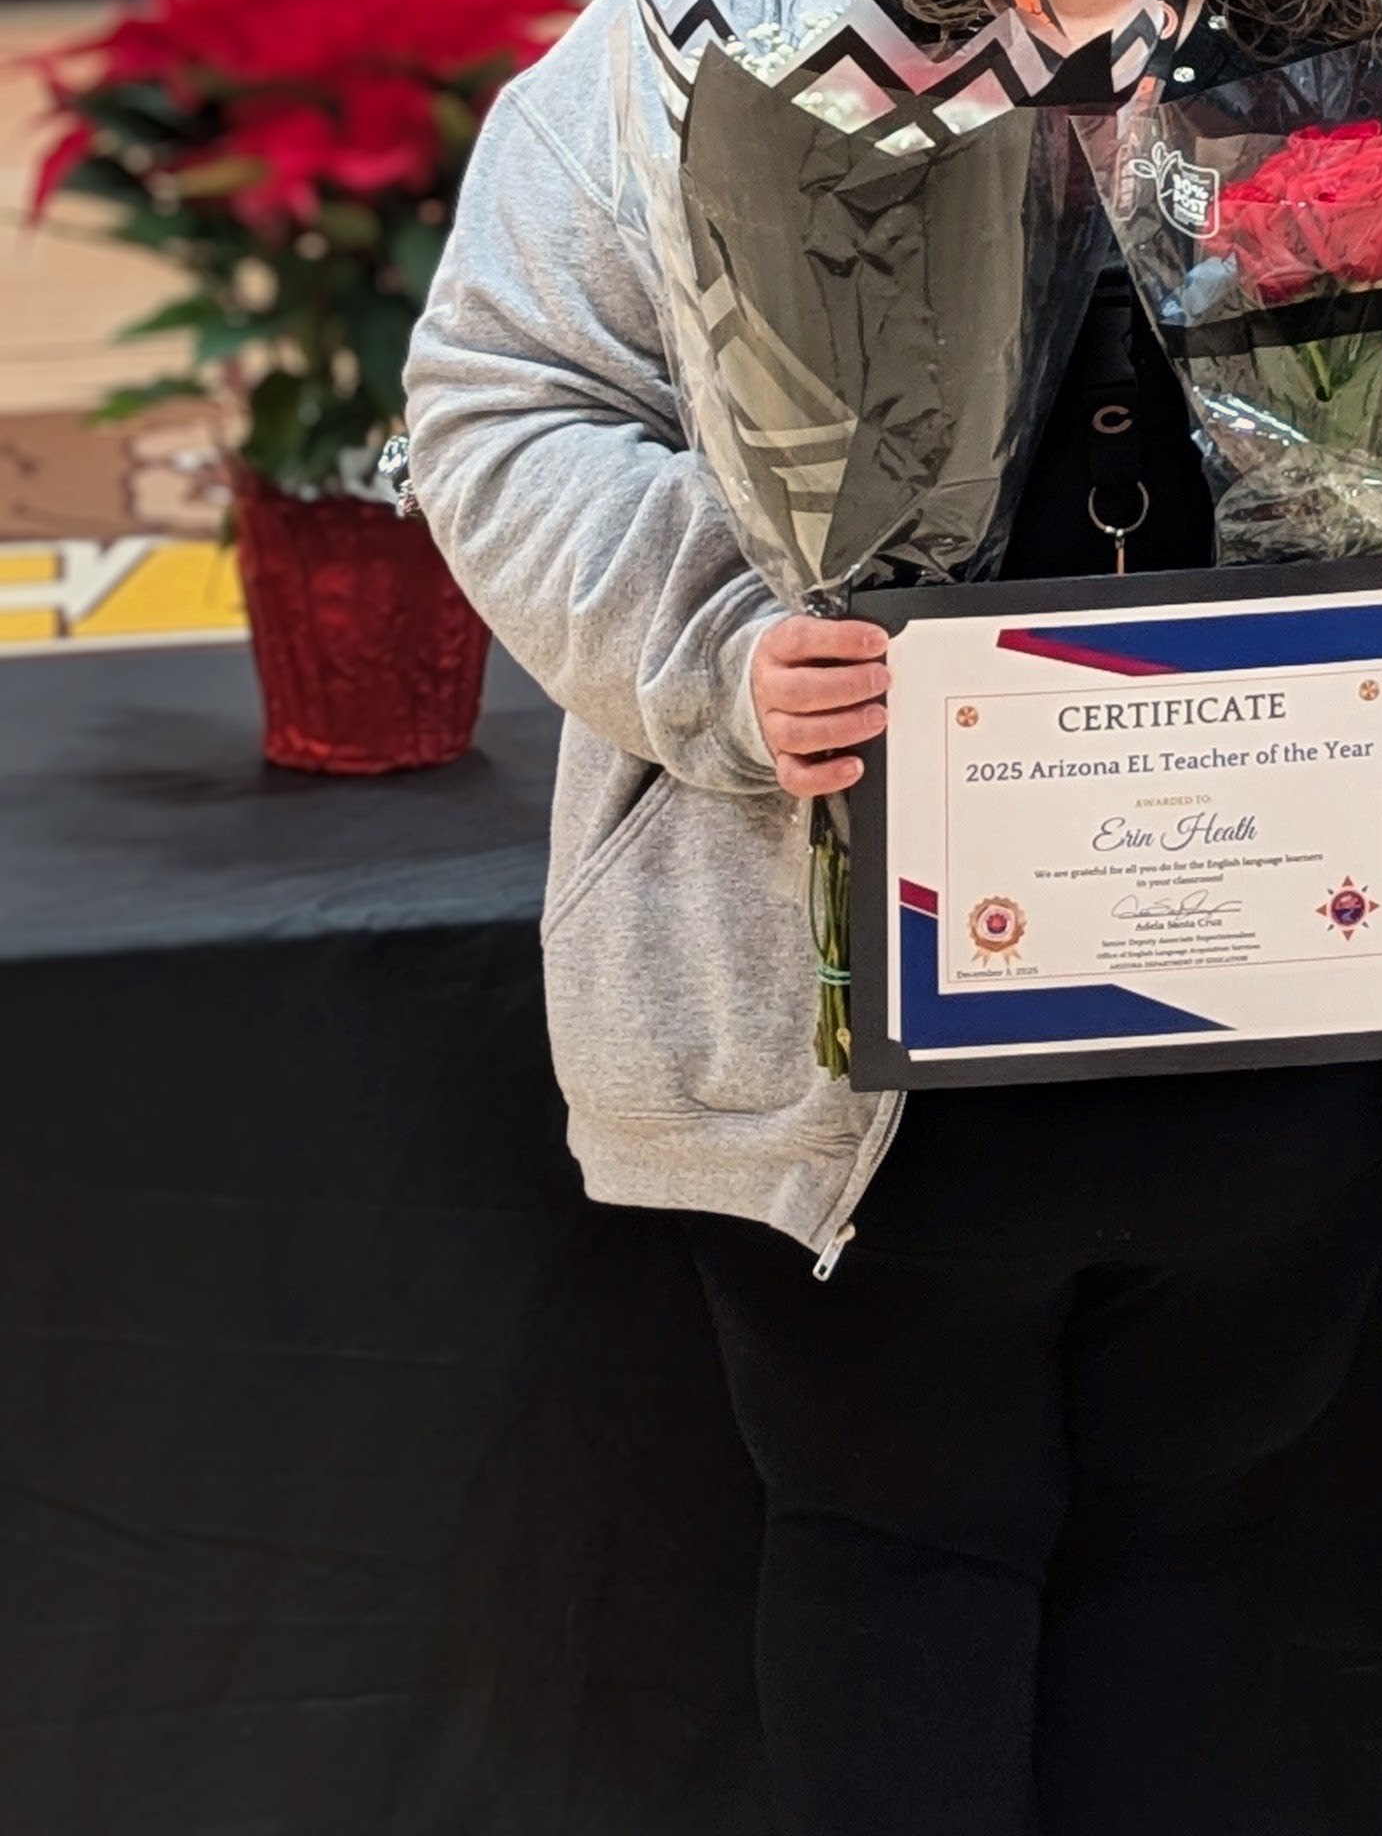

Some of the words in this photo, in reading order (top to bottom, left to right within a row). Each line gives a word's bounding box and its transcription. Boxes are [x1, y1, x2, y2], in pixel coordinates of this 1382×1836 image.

[1058, 692, 1287, 732] CERTIFICATE
[966, 761, 1023, 782] 2025
[1029, 757, 1120, 780] Arizona
[1127, 754, 1154, 773] EL
[1160, 747, 1250, 771] Teacher
[1256, 744, 1279, 764] of
[1284, 742, 1318, 762] the
[1325, 740, 1374, 760] Year
[1135, 796, 1193, 808] AWARDED
[1092, 816, 1154, 852] Erin
[1160, 812, 1257, 852] Heath
[1034, 869, 1051, 878] We
[1053, 870, 1068, 878] are
[1071, 866, 1107, 879] grateful
[1110, 865, 1123, 874] for
[1125, 864, 1137, 874] all
[1140, 865, 1157, 875] you
[1174, 861, 1187, 870] for
[1189, 860, 1204, 869] the
[1207, 858, 1241, 870] English
[1242, 856, 1283, 868] language
[1149, 878, 1171, 889] your
[1135, 920, 1165, 932] Adela
[1167, 918, 1195, 930] Santa
[1197, 917, 1223, 928] Cruz
